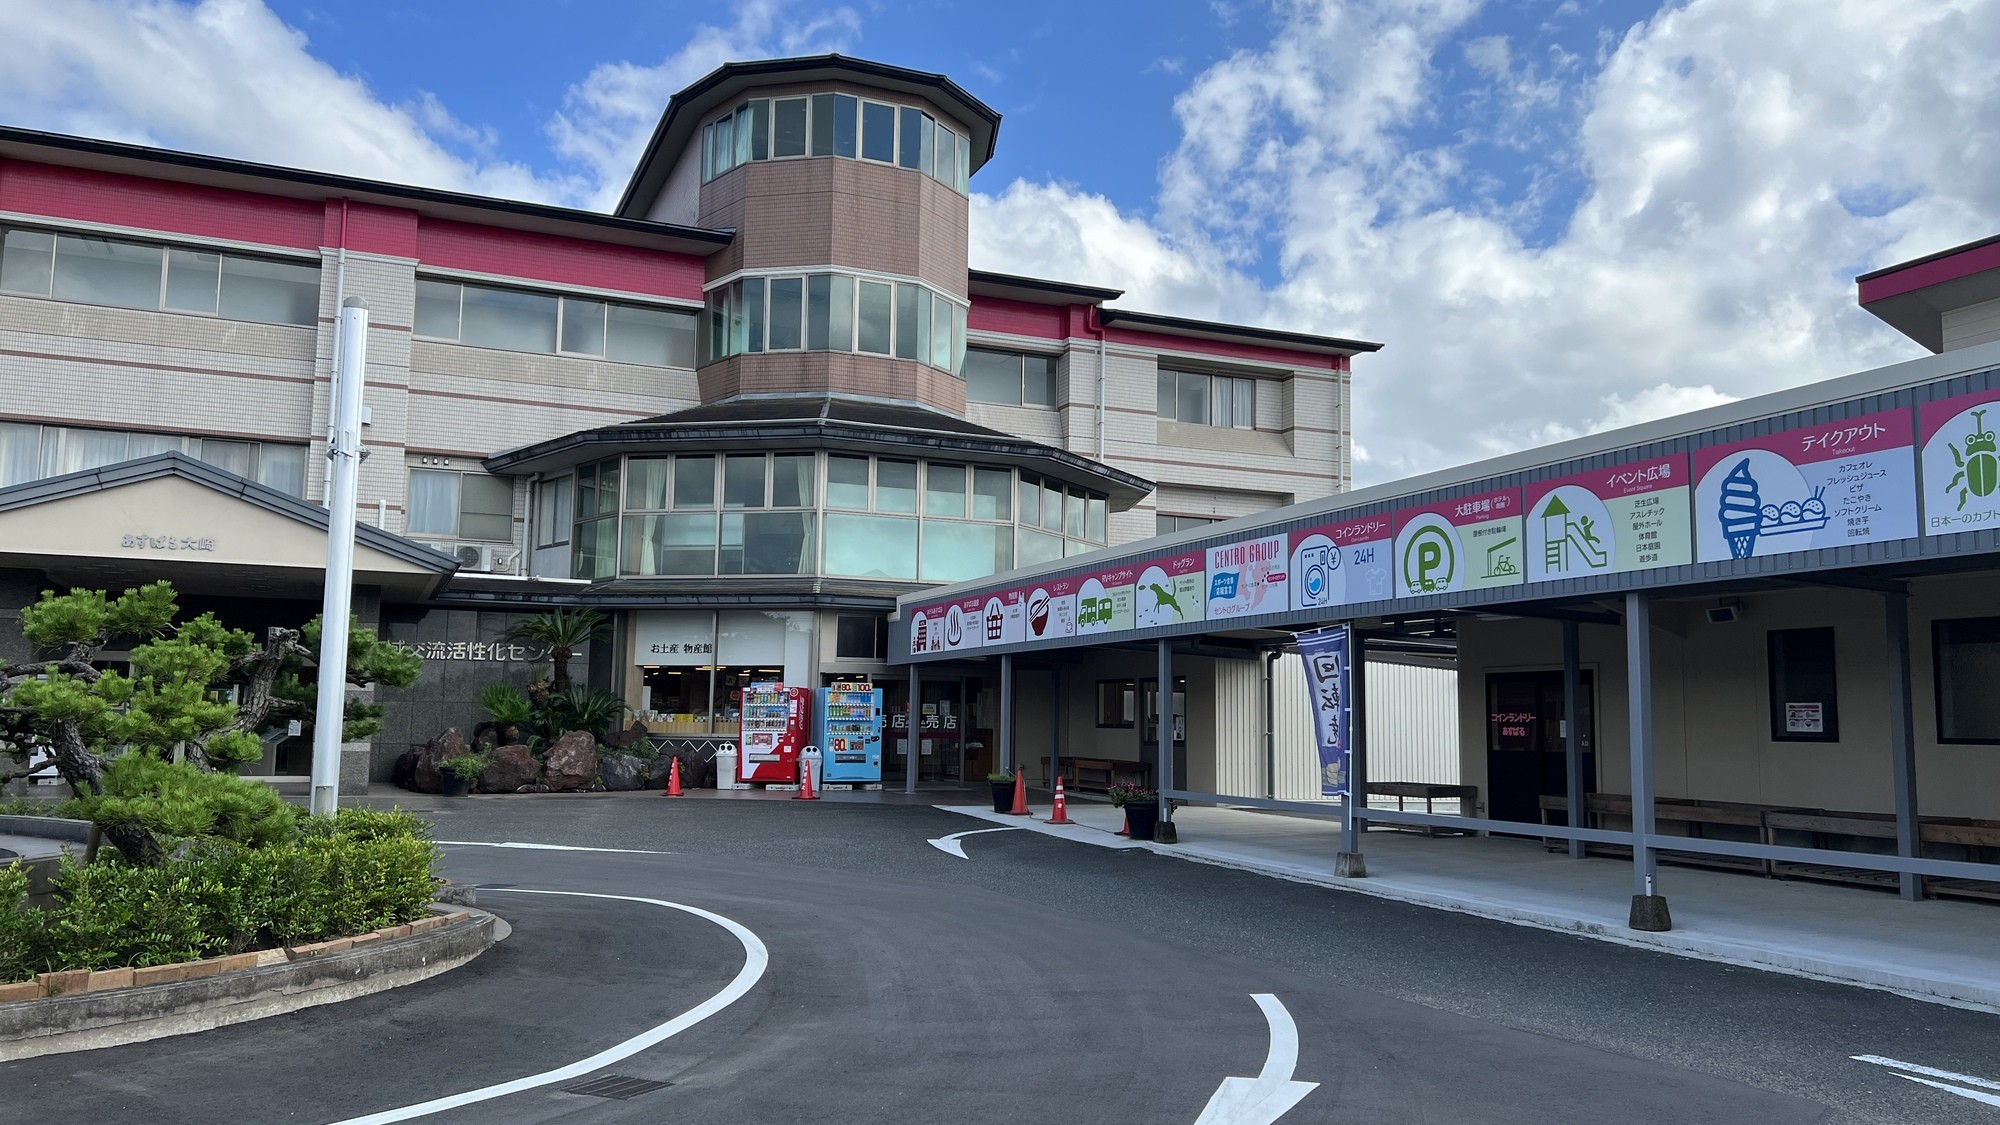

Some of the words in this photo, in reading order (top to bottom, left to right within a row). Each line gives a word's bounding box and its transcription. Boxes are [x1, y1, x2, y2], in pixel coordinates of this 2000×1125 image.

[1801, 422, 1886, 452] テイクアウト
[1832, 446, 1856, 455] Takeout
[1838, 461, 1873, 473] カフェオレ
[1606, 463, 1671, 488] イベント広場
[1827, 469, 1887, 486] フレッシュジュース
[1634, 497, 1660, 509] 芝生広場
[1842, 494, 1872, 505] たこやき
[1454, 499, 1490, 518] 大駐車場
[1629, 507, 1665, 521] アスレチック
[1834, 503, 1882, 517] ソフトクリーム
[1632, 519, 1663, 531] 屋外ホール
[1847, 515, 1870, 527] 焼き芋
[1335, 521, 1387, 540] コインランドリー
[1638, 531, 1658, 541] 体育館
[1636, 541, 1661, 553] 日本庭園
[1214, 546, 1246, 569] CENTRO
[1249, 540, 1280, 563] GROUP
[1354, 547, 1374, 566] 24H
[1172, 557, 1195, 570] ドッグラン
[1214, 602, 1250, 616] セントログループ
[650, 643, 679, 654] お土産
[683, 643, 713, 654] 物産館
[925, 714, 958, 729] 売店
[1491, 712, 1537, 723] コインランドリー
